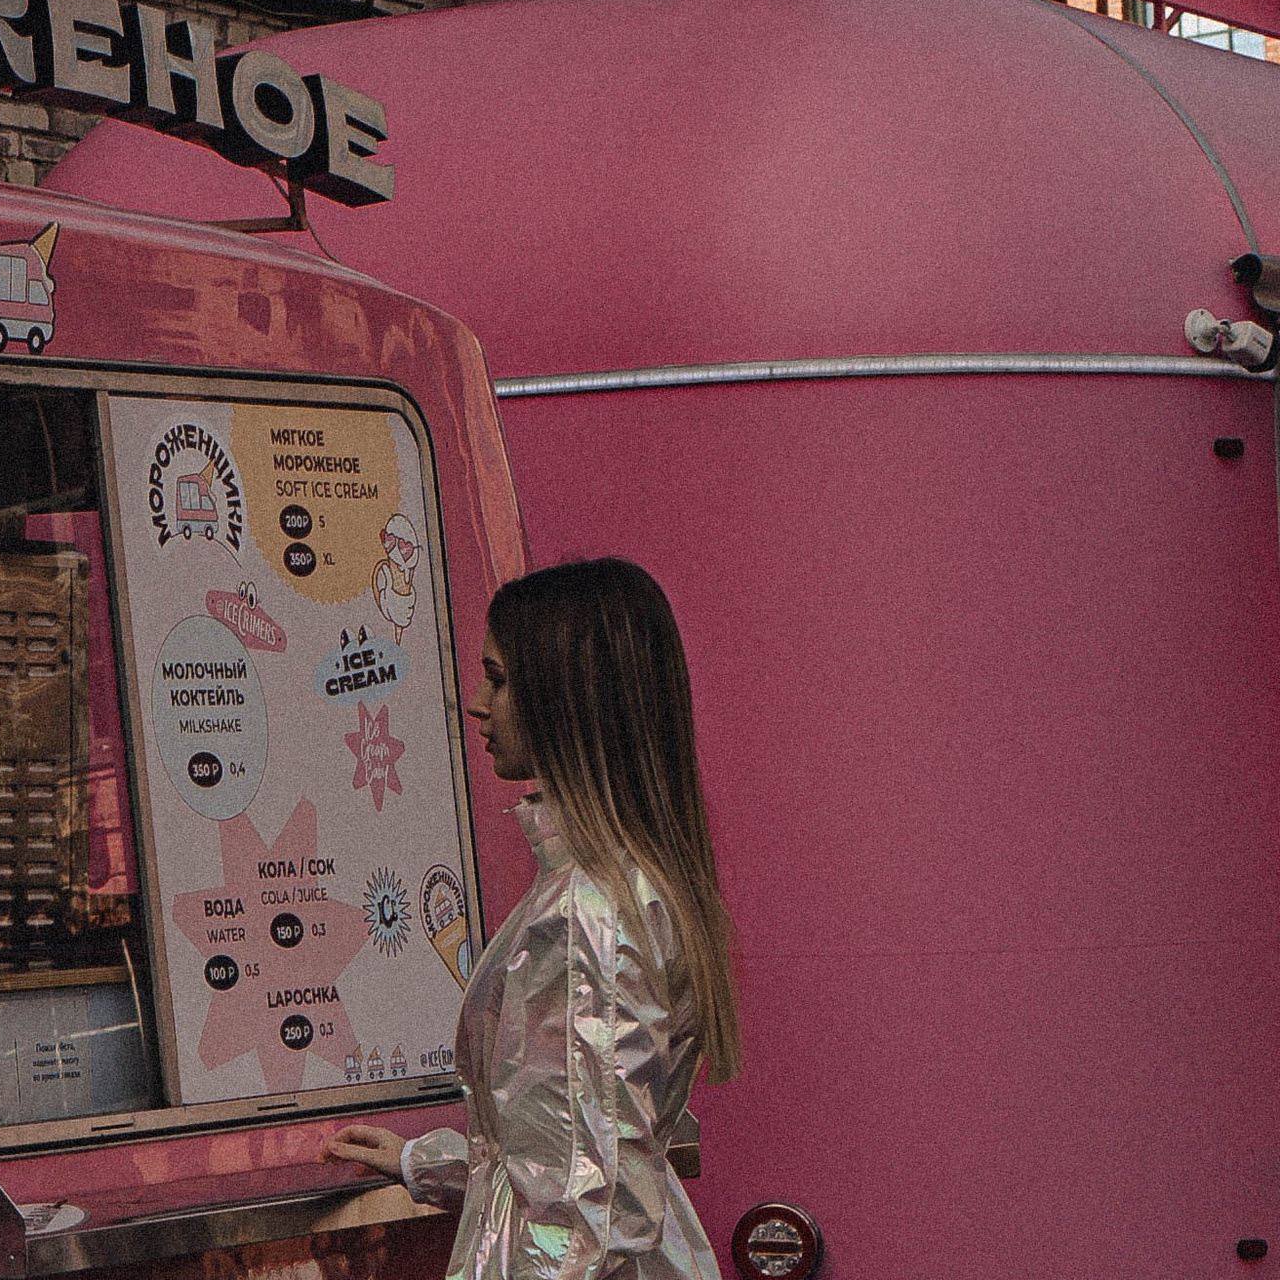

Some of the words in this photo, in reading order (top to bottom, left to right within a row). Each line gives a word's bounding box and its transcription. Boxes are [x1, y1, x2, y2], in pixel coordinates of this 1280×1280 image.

[270, 428, 325, 447] МЯГКОЕ
[273, 454, 361, 474] МОРОЖЕНОЕ
[148, 424, 243, 552] МОРОЖЕНЩИКИ
[276, 480, 308, 497] SOFT
[311, 481, 332, 499] ICE
[334, 482, 379, 500] CREAM
[319, 515, 326, 528] S
[322, 552, 336, 566] XL
[162, 658, 247, 680] МОЛОЧНЫЙ
[342, 649, 376, 672] ICE
[325, 663, 398, 696] CREAM
[171, 685, 245, 707] КОКТЕЙЛЬ
[179, 718, 243, 733] MILKSHAKE
[258, 860, 298, 879] КОЛА
[308, 858, 336, 876] СОК
[203, 898, 246, 919] ВОДА
[206, 927, 247, 944] WATER
[312, 922, 327, 939] 0,3
[244, 963, 260, 979] 0,5
[267, 985, 340, 1009] LAPOCHKA
[319, 1022, 334, 1039] 0,3
